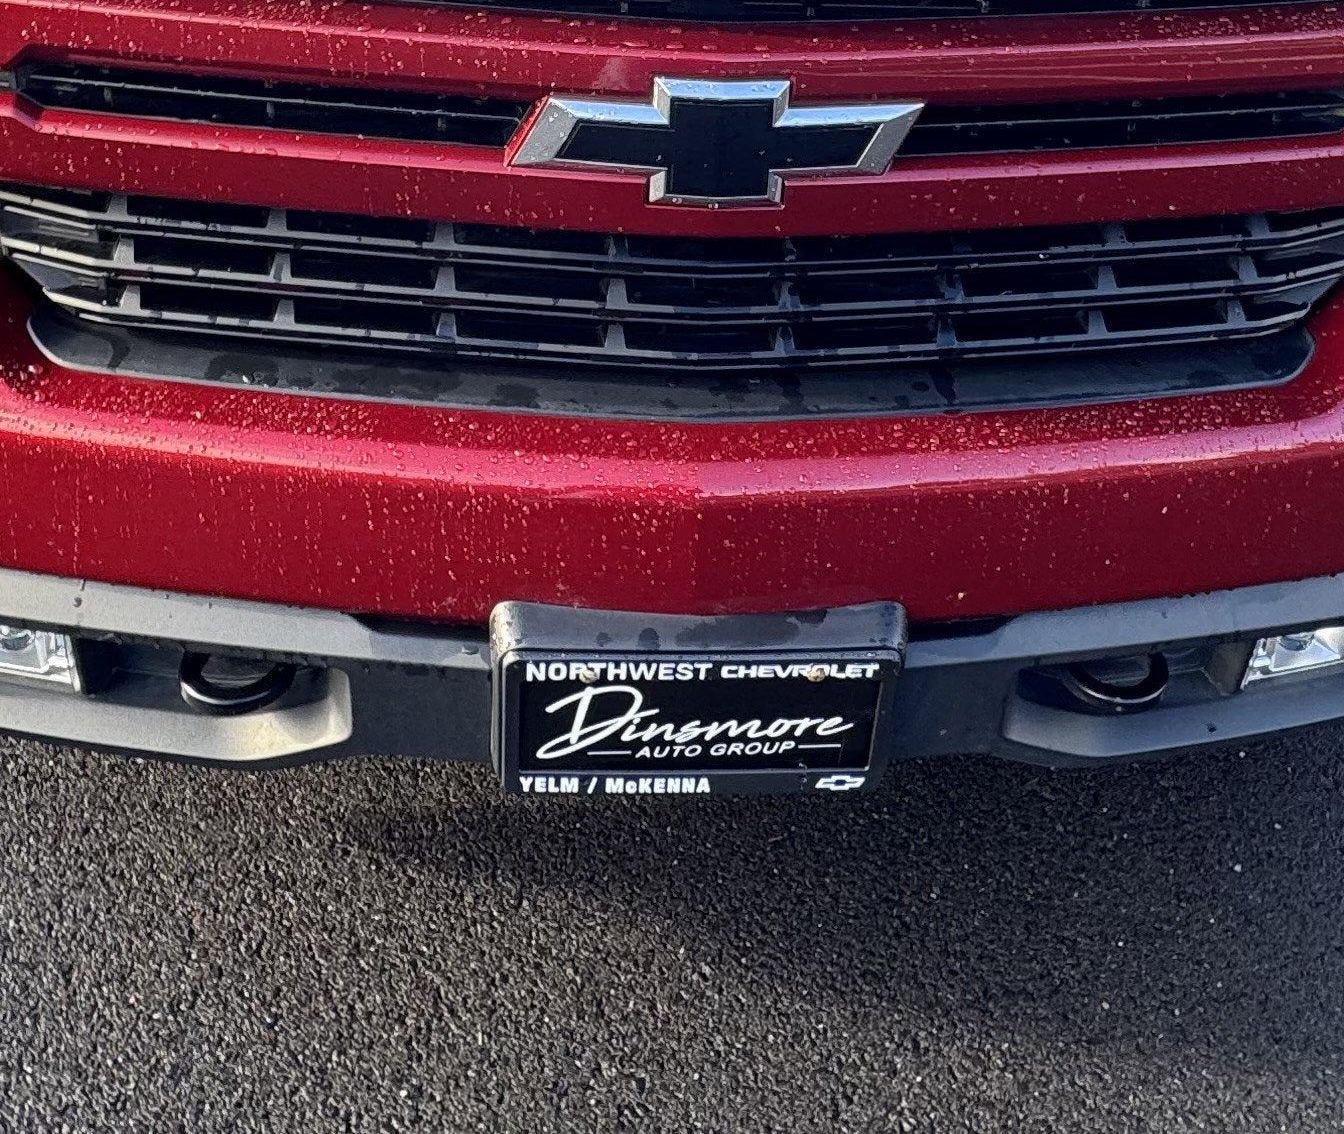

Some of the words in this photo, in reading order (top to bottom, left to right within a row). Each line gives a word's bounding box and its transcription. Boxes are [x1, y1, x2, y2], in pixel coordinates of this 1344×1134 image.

[525, 662, 713, 682] NORTHWEST
[720, 663, 880, 679] CHEVROLET
[536, 685, 854, 759] Dinsmore
[635, 745, 701, 758] AUTO
[711, 741, 795, 756] GROUP
[519, 776, 579, 794] YELM
[605, 777, 711, 794] McKENNA
